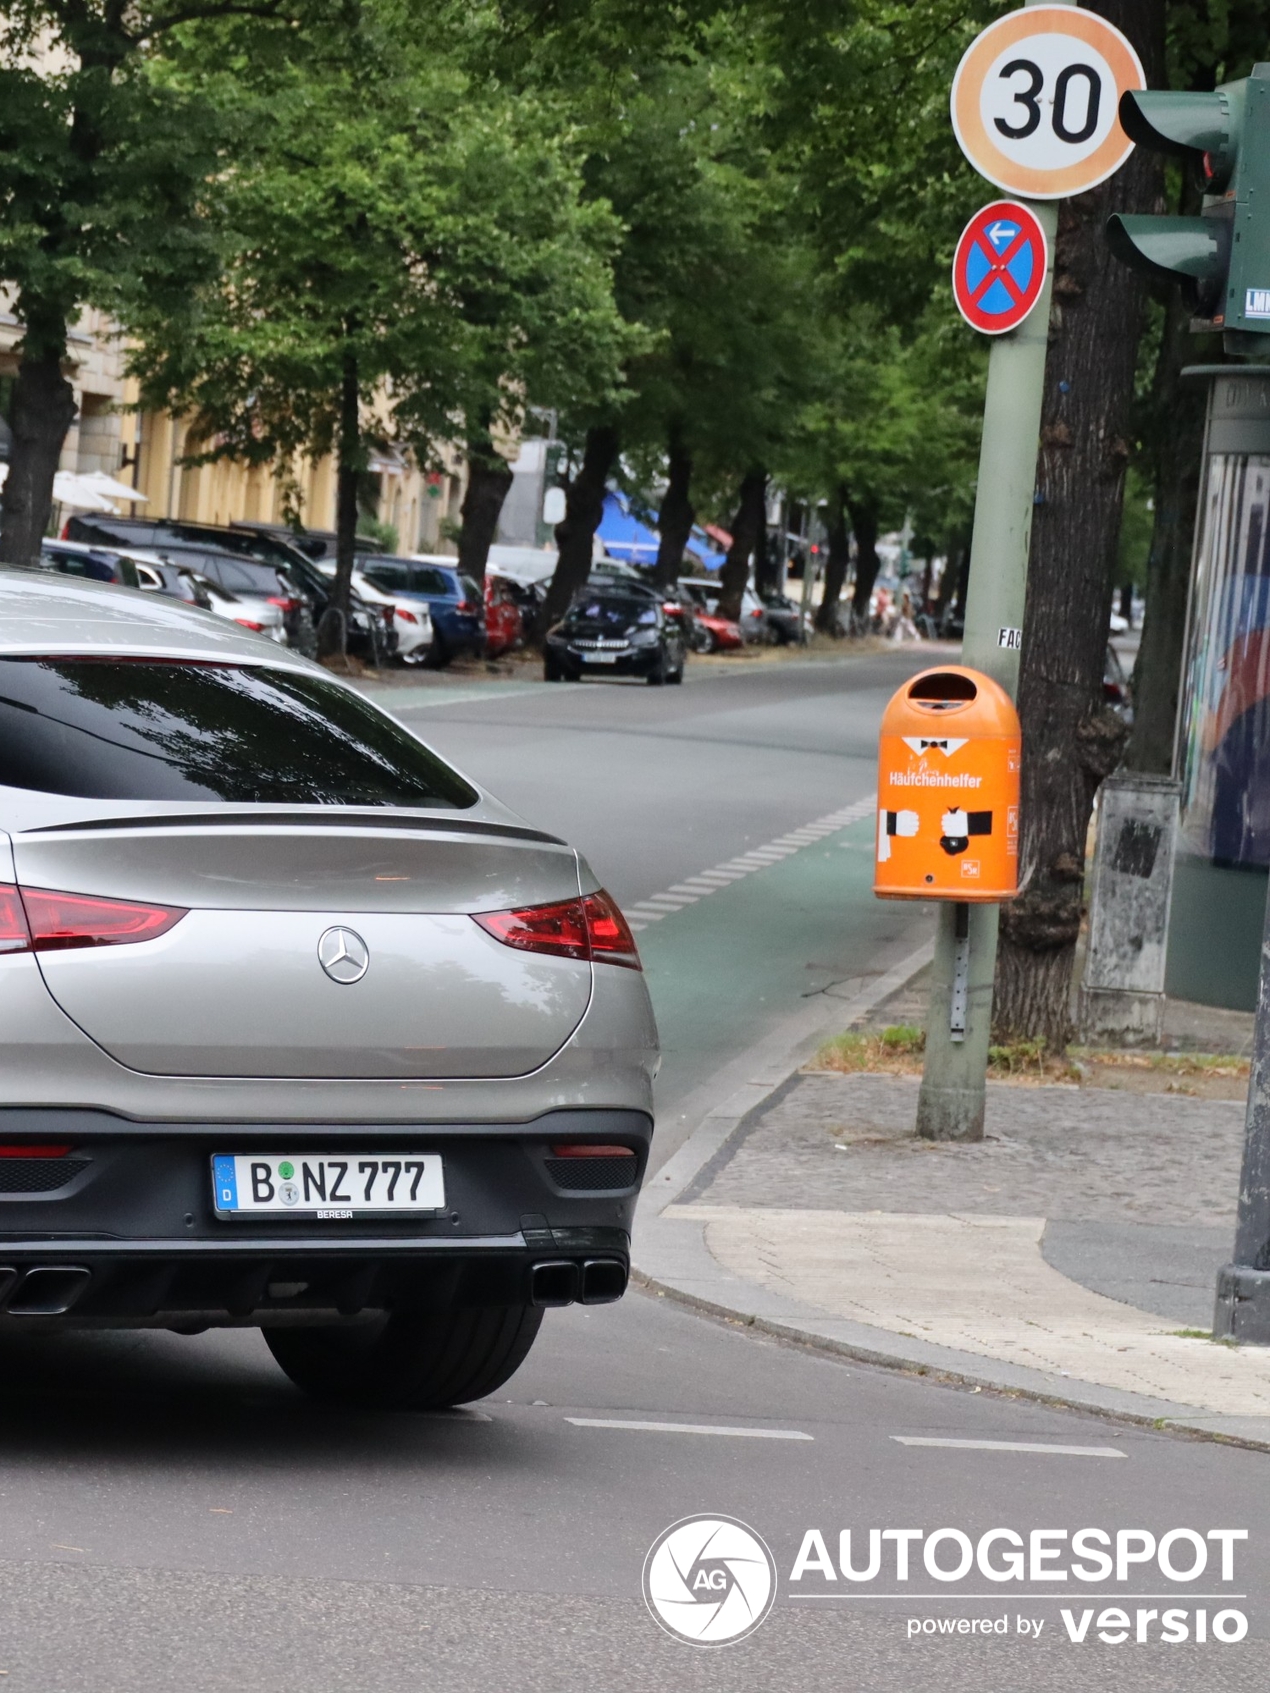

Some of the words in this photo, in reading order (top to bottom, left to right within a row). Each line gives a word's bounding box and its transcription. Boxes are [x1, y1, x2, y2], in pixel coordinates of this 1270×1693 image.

[994, 59, 1102, 144] 30
[890, 771, 982, 788] Häufchenhelfer
[963, 863, 979, 875] BSR
[250, 1162, 275, 1203] B
[302, 1161, 352, 1202] NZ
[358, 1161, 425, 1202] 777
[222, 1189, 232, 1202] D
[317, 1210, 353, 1219] BERESA
